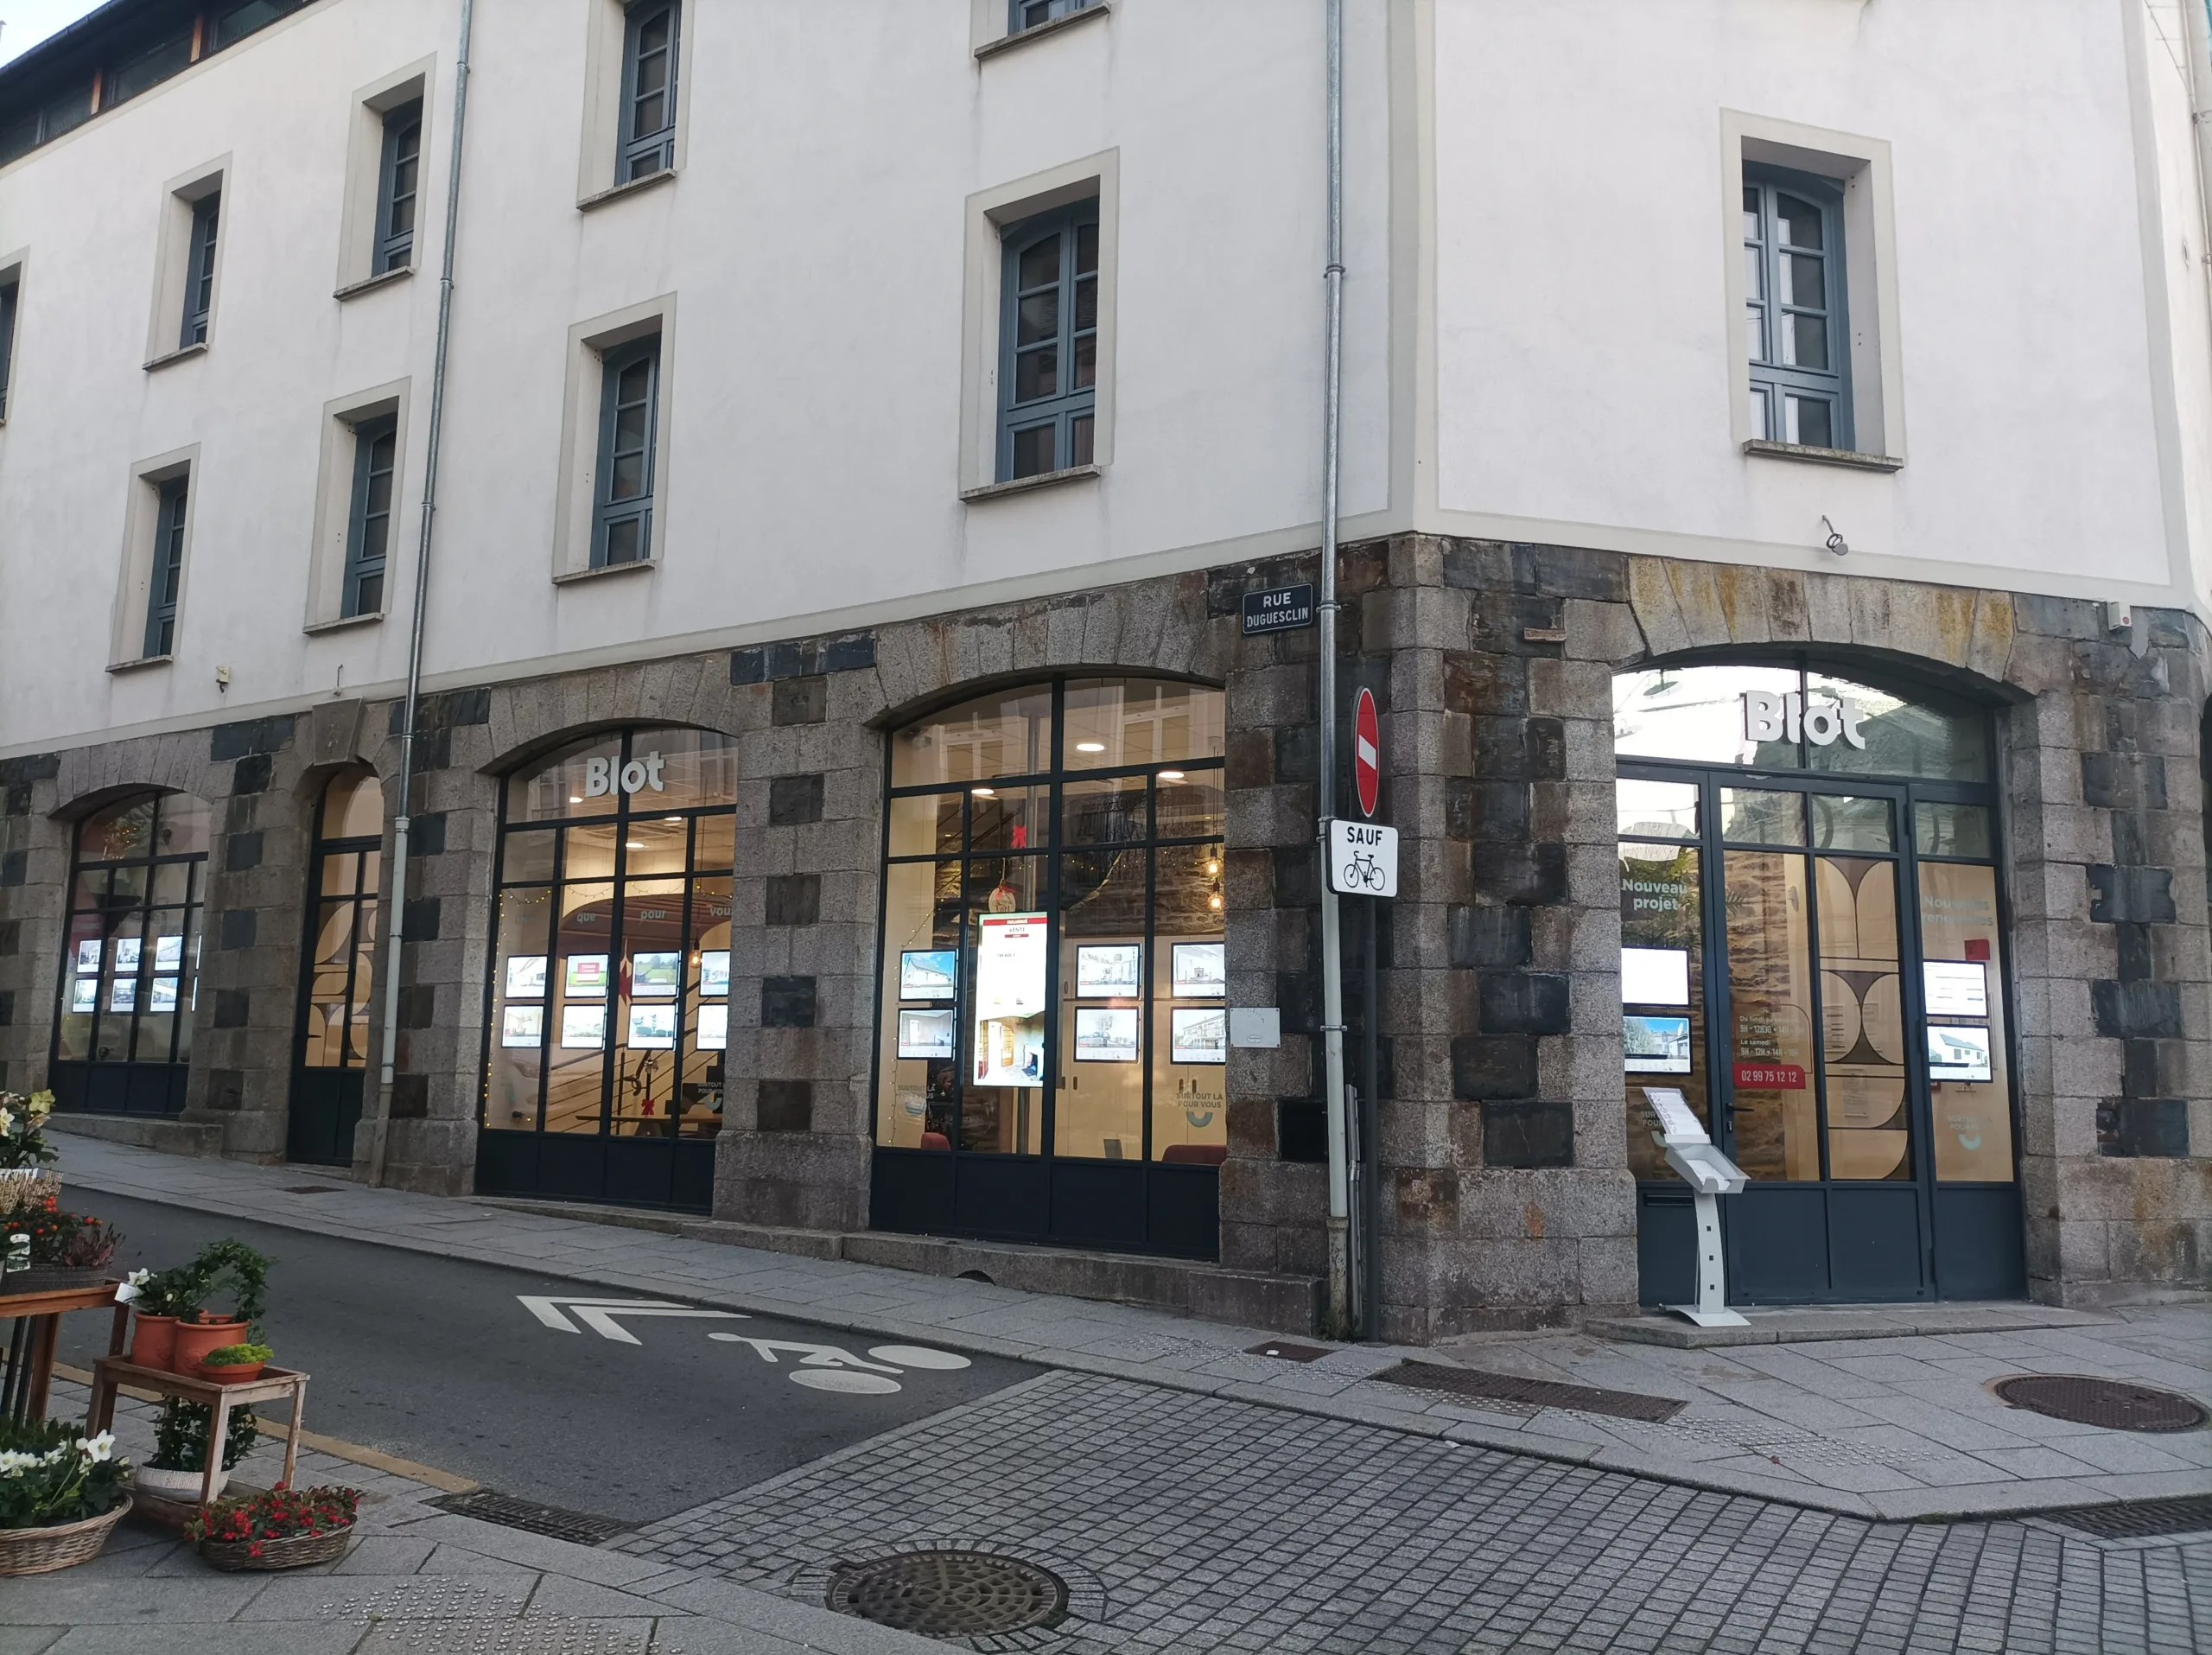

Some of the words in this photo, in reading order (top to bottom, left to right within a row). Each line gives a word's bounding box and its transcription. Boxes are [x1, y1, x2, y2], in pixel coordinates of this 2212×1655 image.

[1262, 591, 1292, 608] RUE
[1247, 607, 1308, 627] DUGUESCLIN
[1743, 690, 1866, 751] Blot
[585, 750, 665, 798] Blot
[1346, 826, 1383, 847] SAUF
[1622, 878, 1688, 894] Nouveau
[1633, 896, 1678, 912] projet
[576, 911, 596, 925] que
[639, 908, 668, 924] pour
[709, 904, 733, 917] vou
[1741, 1070, 1751, 1082] 02
[1752, 1070, 1764, 1082] 99
[1764, 1071, 1775, 1082] 75
[1777, 1071, 1786, 1082] 12
[1789, 1072, 1797, 1083] 12
[1176, 1092, 1211, 1100] SURTOUT
[1213, 1092, 1224, 1100] LÀ
[1201, 1100, 1222, 1109] VOUS
